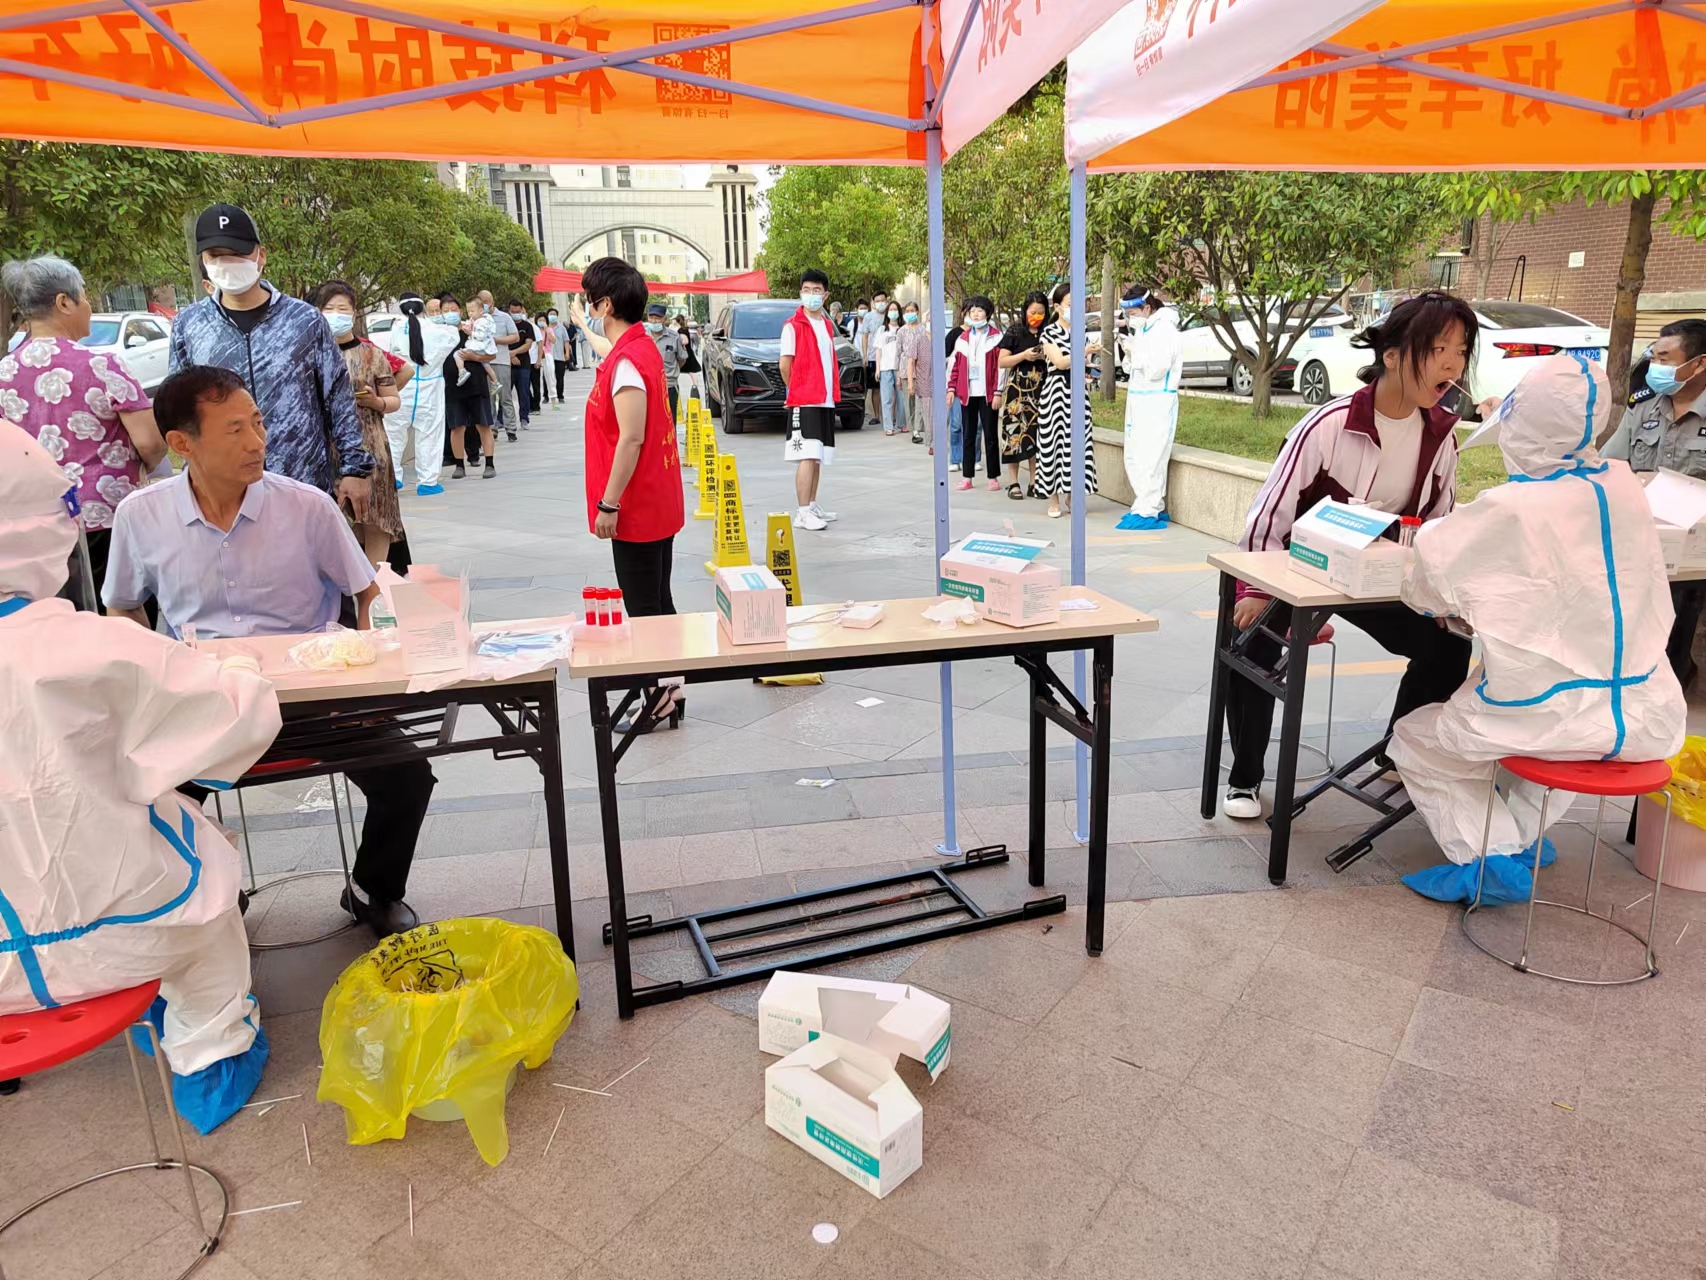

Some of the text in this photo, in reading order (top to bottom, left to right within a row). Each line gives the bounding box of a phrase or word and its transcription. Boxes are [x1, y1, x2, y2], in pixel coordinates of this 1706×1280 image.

[219, 216, 230, 229] P
[705, 460, 715, 492] 环评检测
[725, 500, 737, 514] 商标
